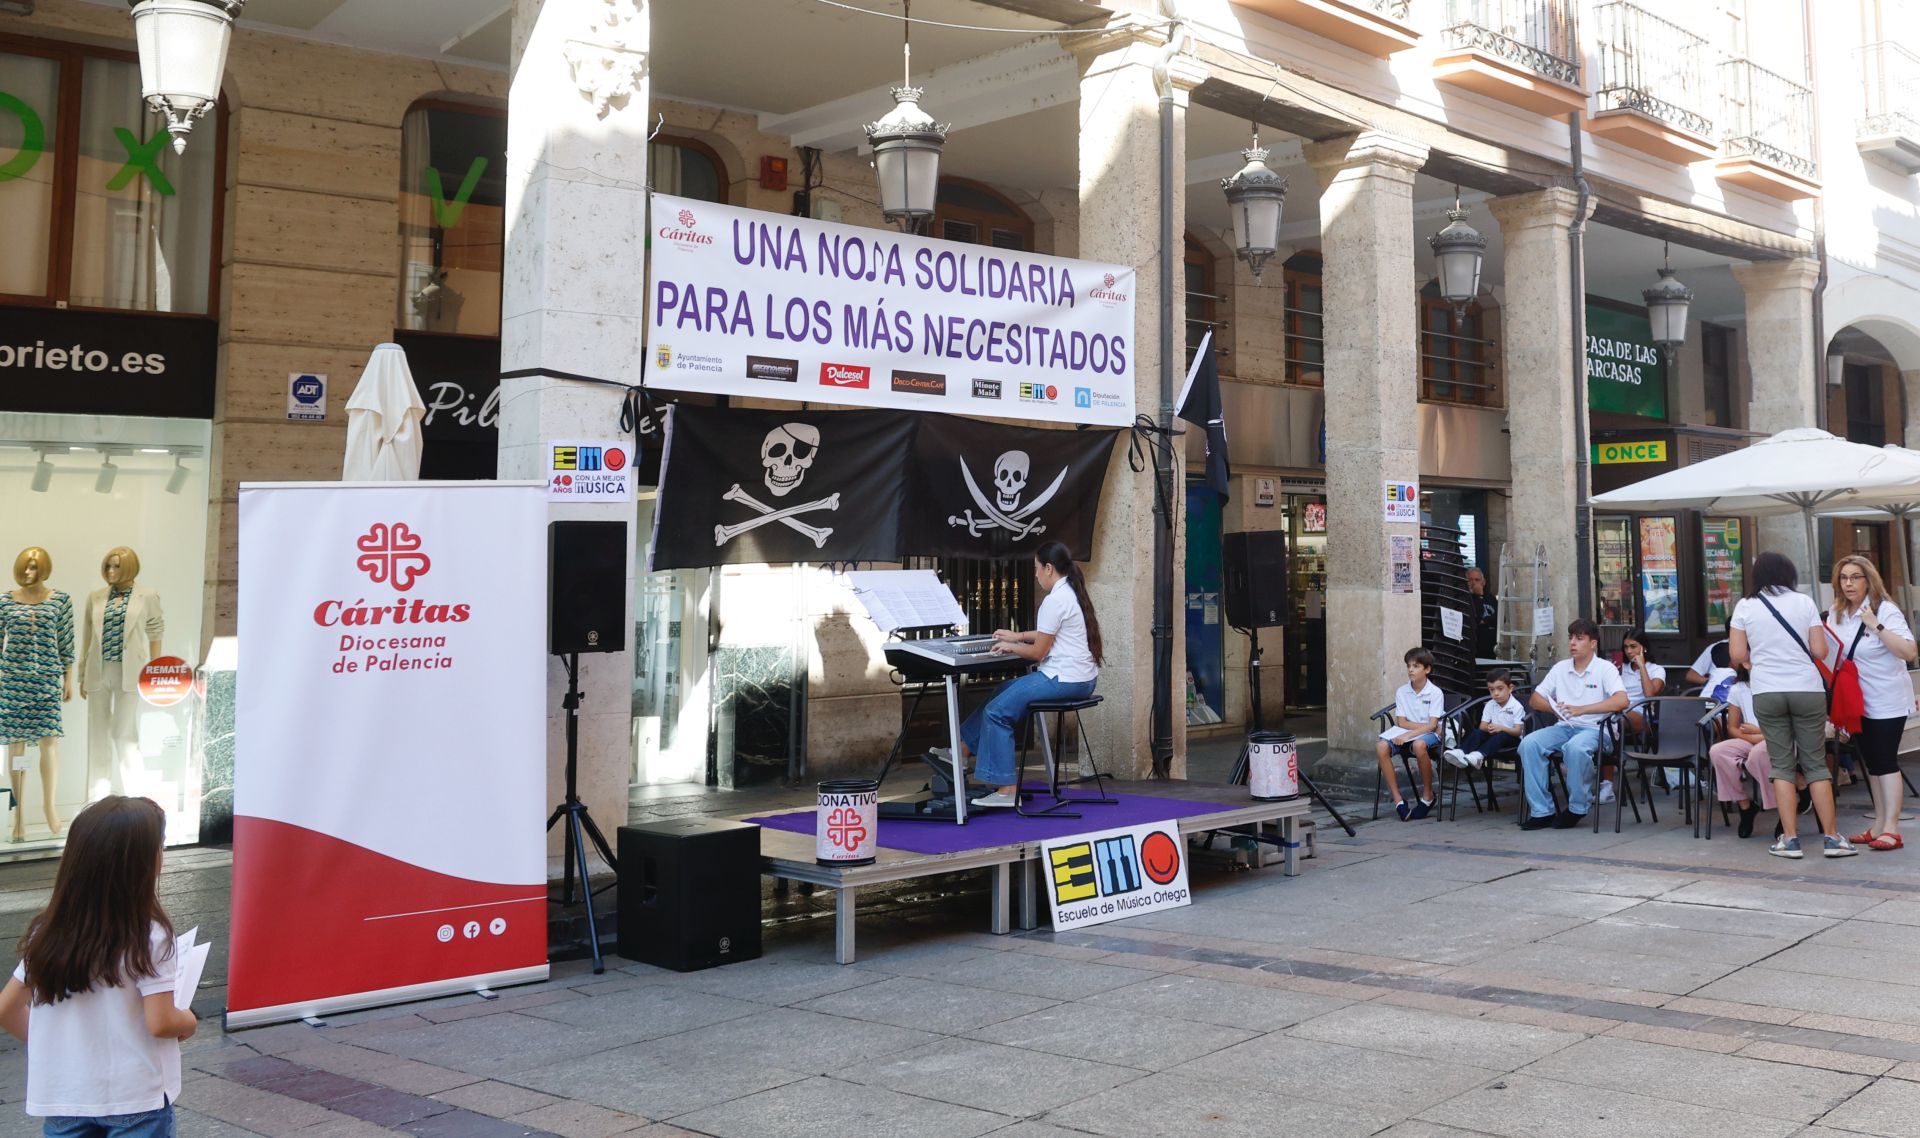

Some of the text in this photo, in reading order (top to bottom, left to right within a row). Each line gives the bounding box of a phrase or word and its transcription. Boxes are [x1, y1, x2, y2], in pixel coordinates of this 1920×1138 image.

[659, 226, 714, 245] Cáritas
[733, 218, 807, 274] UNA
[915, 247, 1075, 308] SOLIDARIA
[1089, 288, 1127, 302] Cáritas
[656, 280, 1126, 376] PARA LOS MÁS NECESITADOS
[677, 353, 723, 364] Ayuntamiento
[1617, 341, 1632, 361] DE
[1635, 344, 1658, 366] LAS
[689, 363, 723, 373] Palencia
[826, 366, 864, 381] Dulcesol
[296, 384, 319, 396] ADT
[424, 381, 500, 428] Pil
[1605, 444, 1659, 461] ONCE
[553, 486, 573, 494] AÑOS
[313, 598, 471, 627] Cáritas
[339, 634, 446, 652] Diocesana
[145, 664, 187, 675] REMATE
[332, 652, 453, 674] de Palencia
[150, 676, 182, 686] FINAL
[1058, 888, 1188, 923] Escuela de Música Ortega
